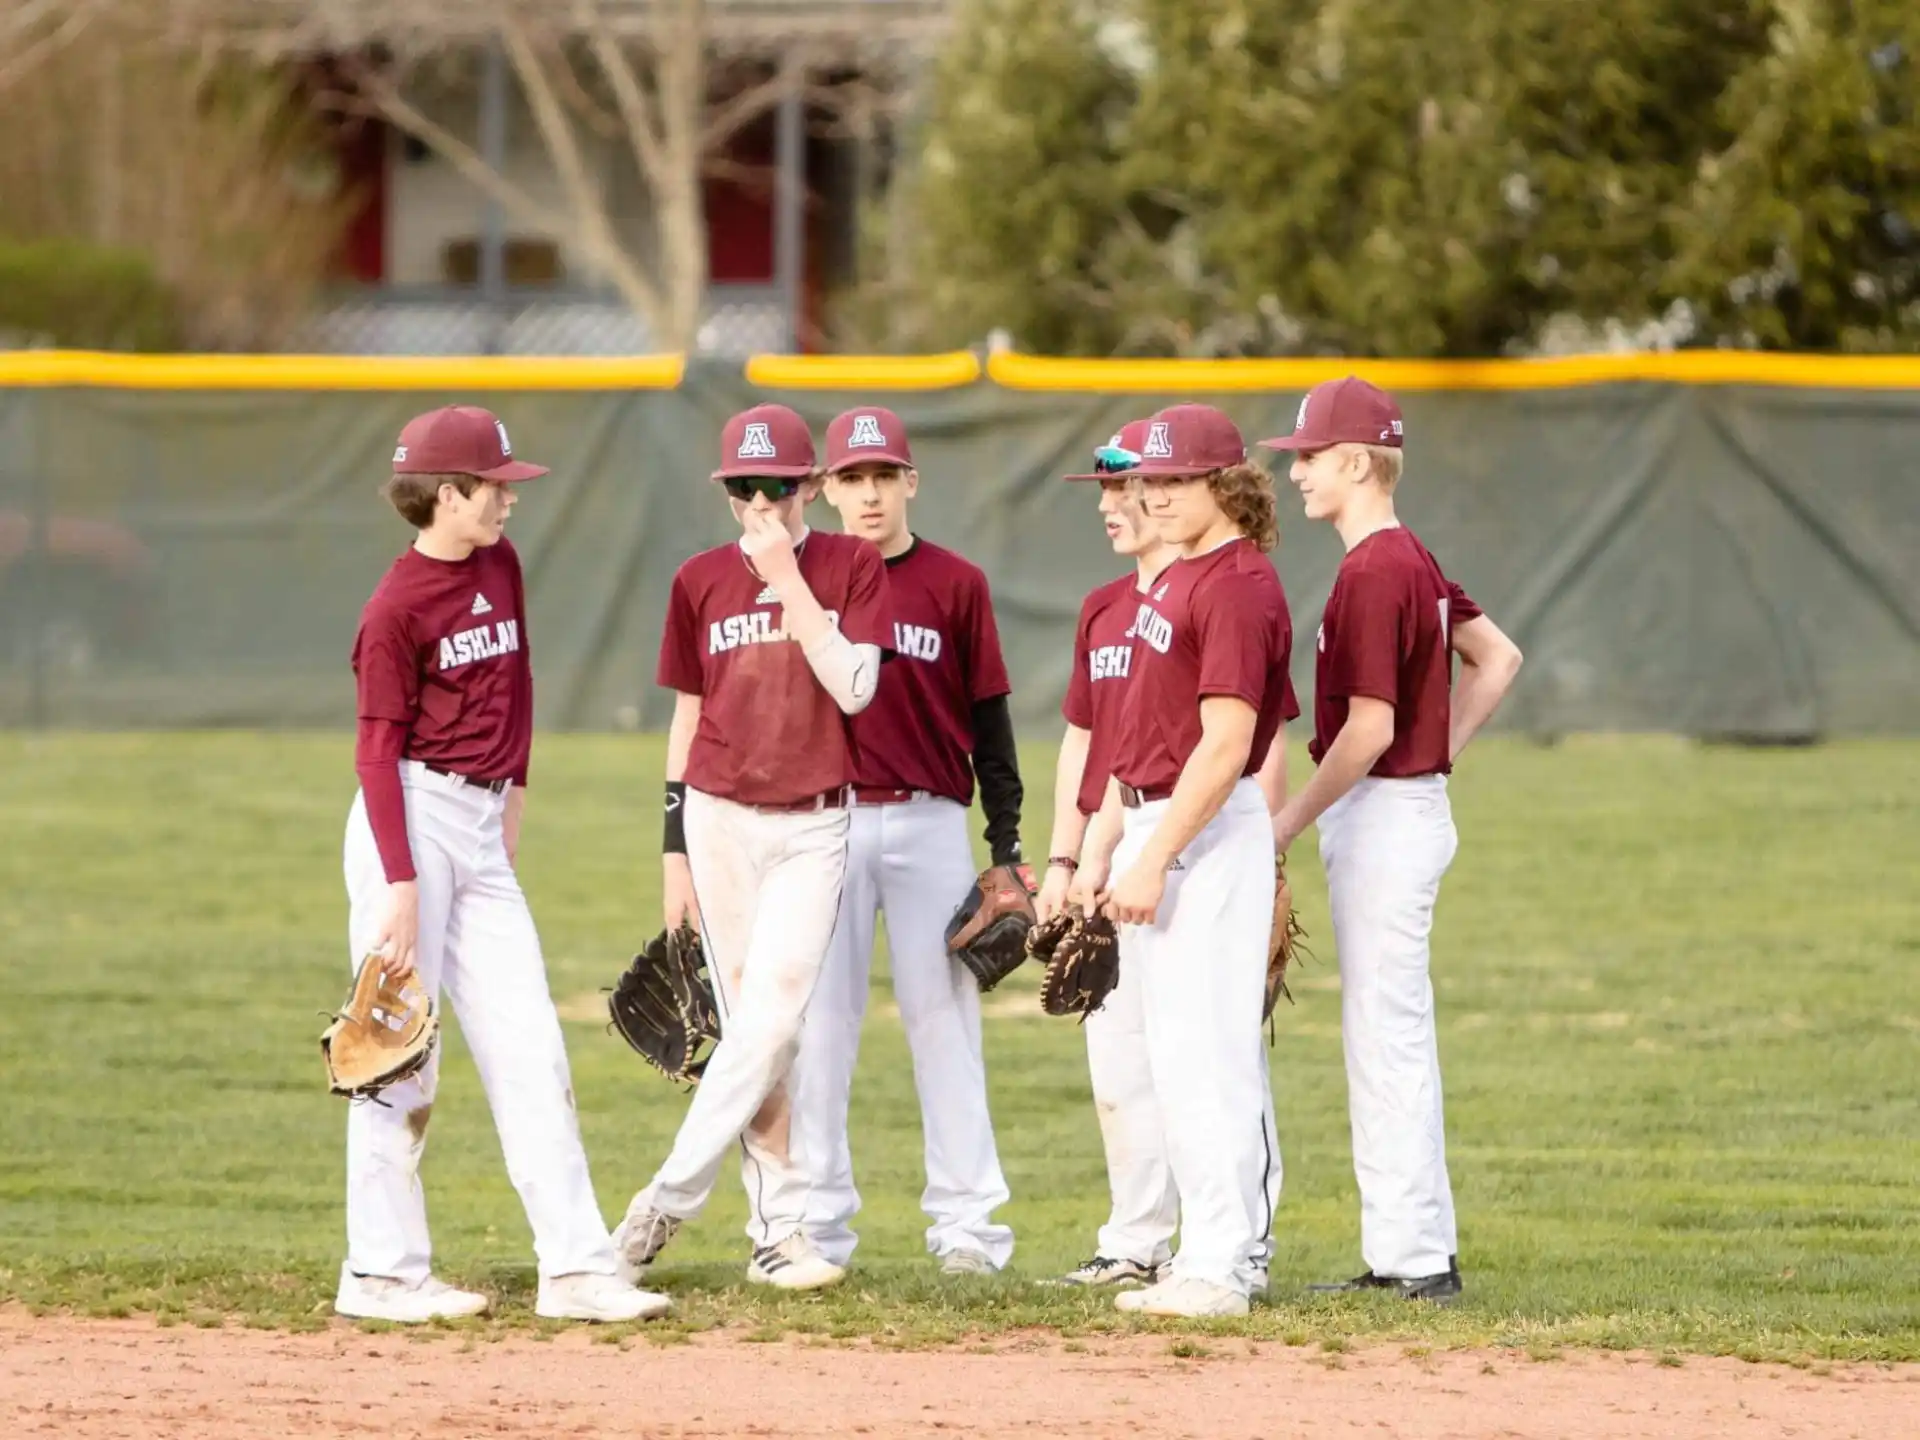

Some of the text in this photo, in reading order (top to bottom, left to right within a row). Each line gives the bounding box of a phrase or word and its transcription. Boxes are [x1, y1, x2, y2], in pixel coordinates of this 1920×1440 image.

[738, 423, 776, 458] A
[848, 415, 886, 448] A
[1143, 422, 1172, 458] A
[439, 619, 518, 670] ASHLAN
